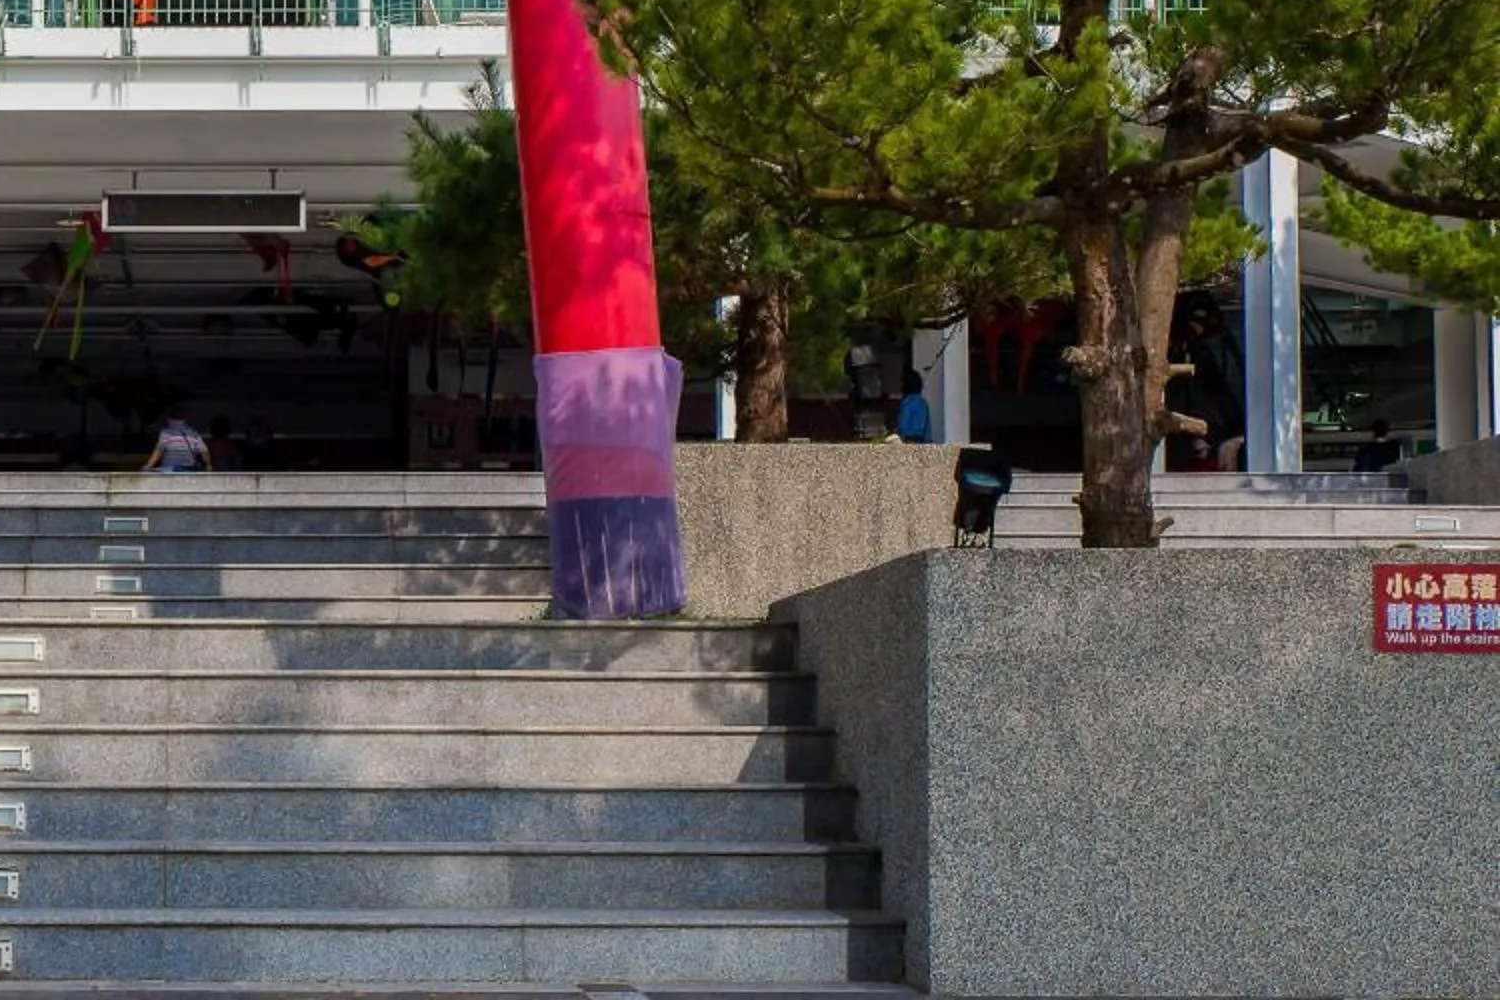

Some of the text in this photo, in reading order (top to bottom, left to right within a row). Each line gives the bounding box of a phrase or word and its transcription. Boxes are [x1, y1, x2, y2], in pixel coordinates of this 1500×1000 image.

[1386, 572, 1497, 600] 小心高落
[1385, 631, 1417, 644] Walk
[1421, 635, 1437, 646] up
[1441, 632, 1461, 644] the
